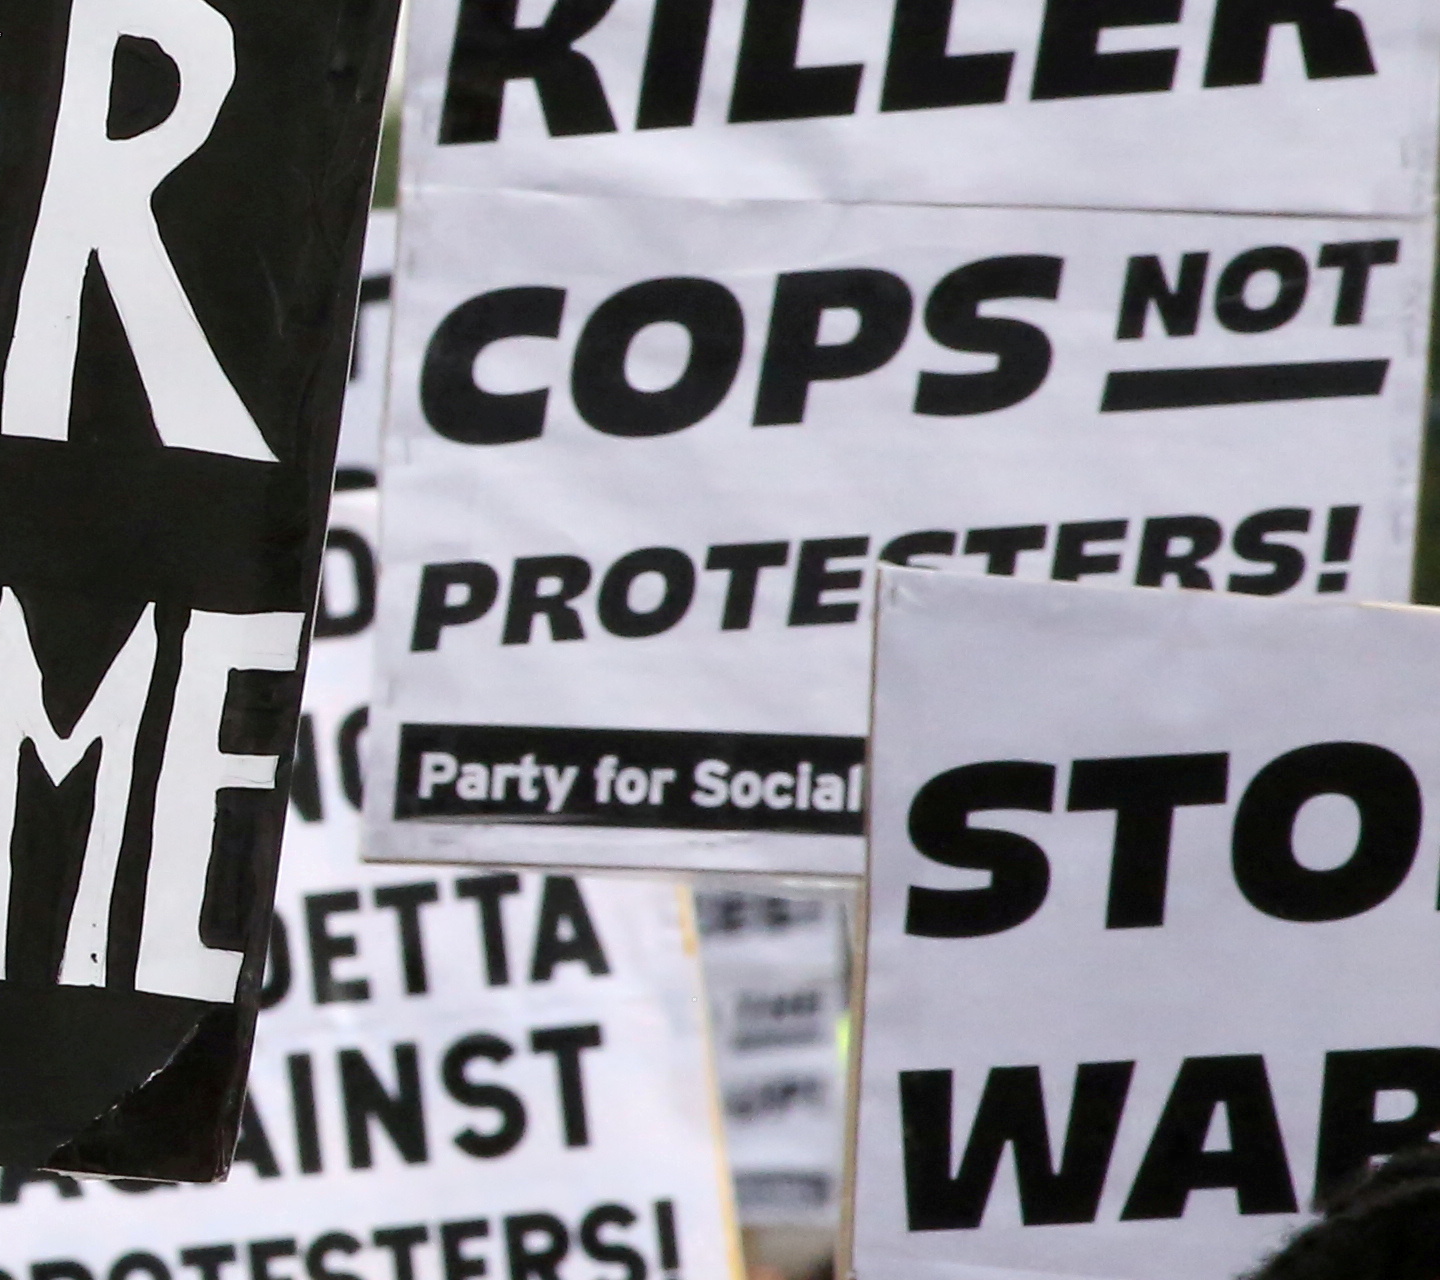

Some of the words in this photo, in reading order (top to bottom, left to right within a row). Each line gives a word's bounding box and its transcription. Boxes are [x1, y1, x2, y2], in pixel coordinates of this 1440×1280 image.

[419, 254, 1064, 445] COPS
[1115, 238, 1401, 342] NOT
[418, 751, 578, 814] Party
[593, 755, 675, 805] for
[903, 740, 1440, 939] STO
